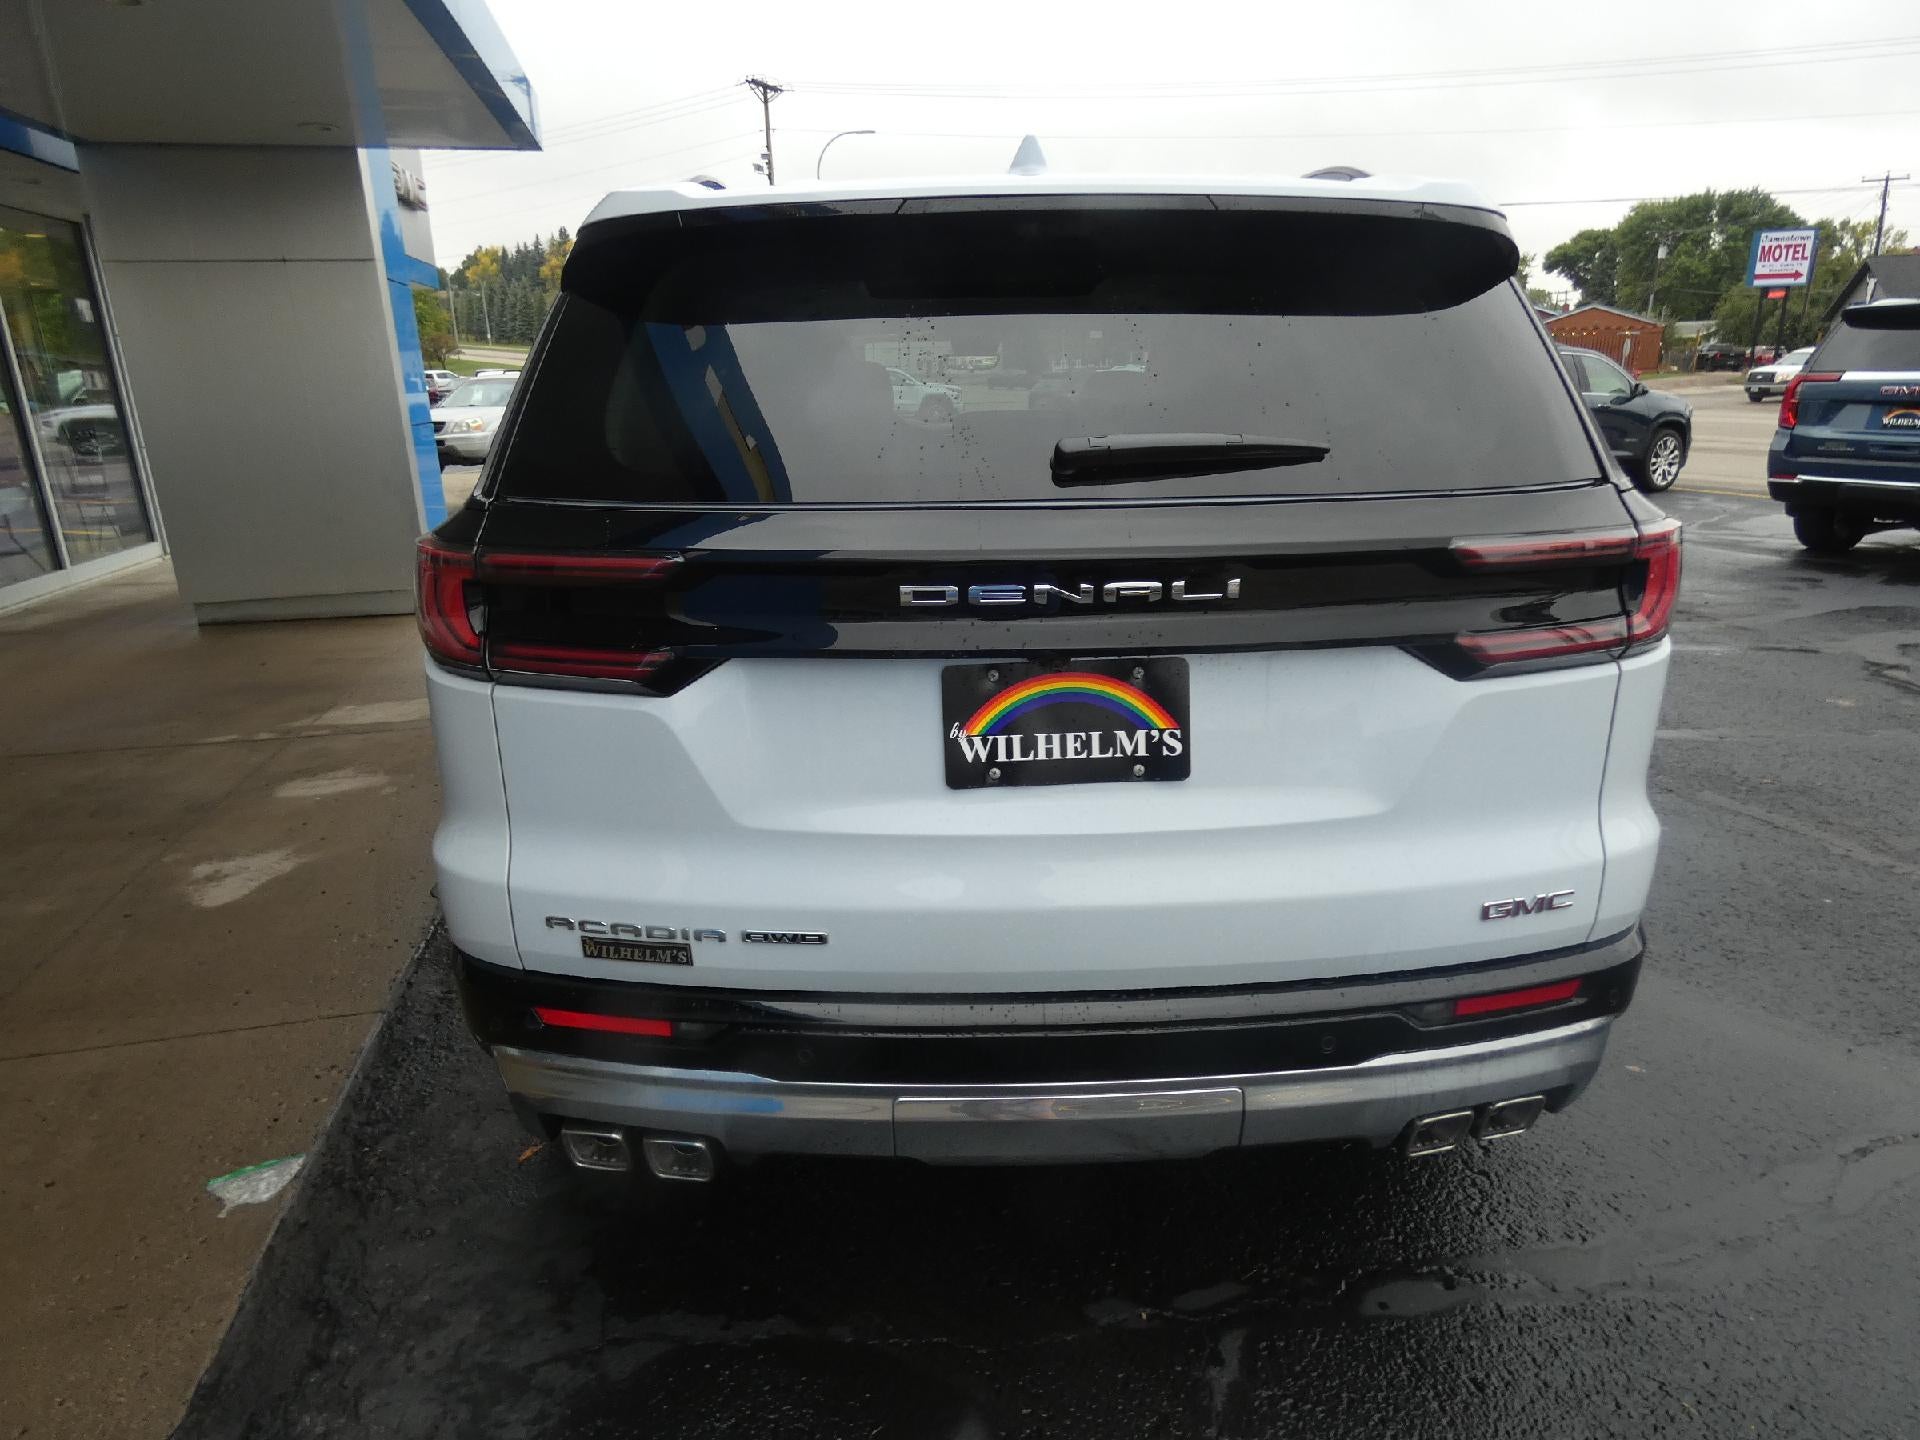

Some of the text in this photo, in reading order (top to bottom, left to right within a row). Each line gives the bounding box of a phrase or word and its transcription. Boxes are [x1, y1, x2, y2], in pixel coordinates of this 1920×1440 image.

[1759, 243, 1809, 262] MOTEL
[899, 578, 1241, 606] DENALI
[950, 721, 967, 742] by
[957, 728, 1183, 763] WILHELM'S
[1480, 889, 1575, 920] GMC
[545, 915, 828, 944] ACADIA AWD
[584, 943, 688, 963] WILHELM'S
